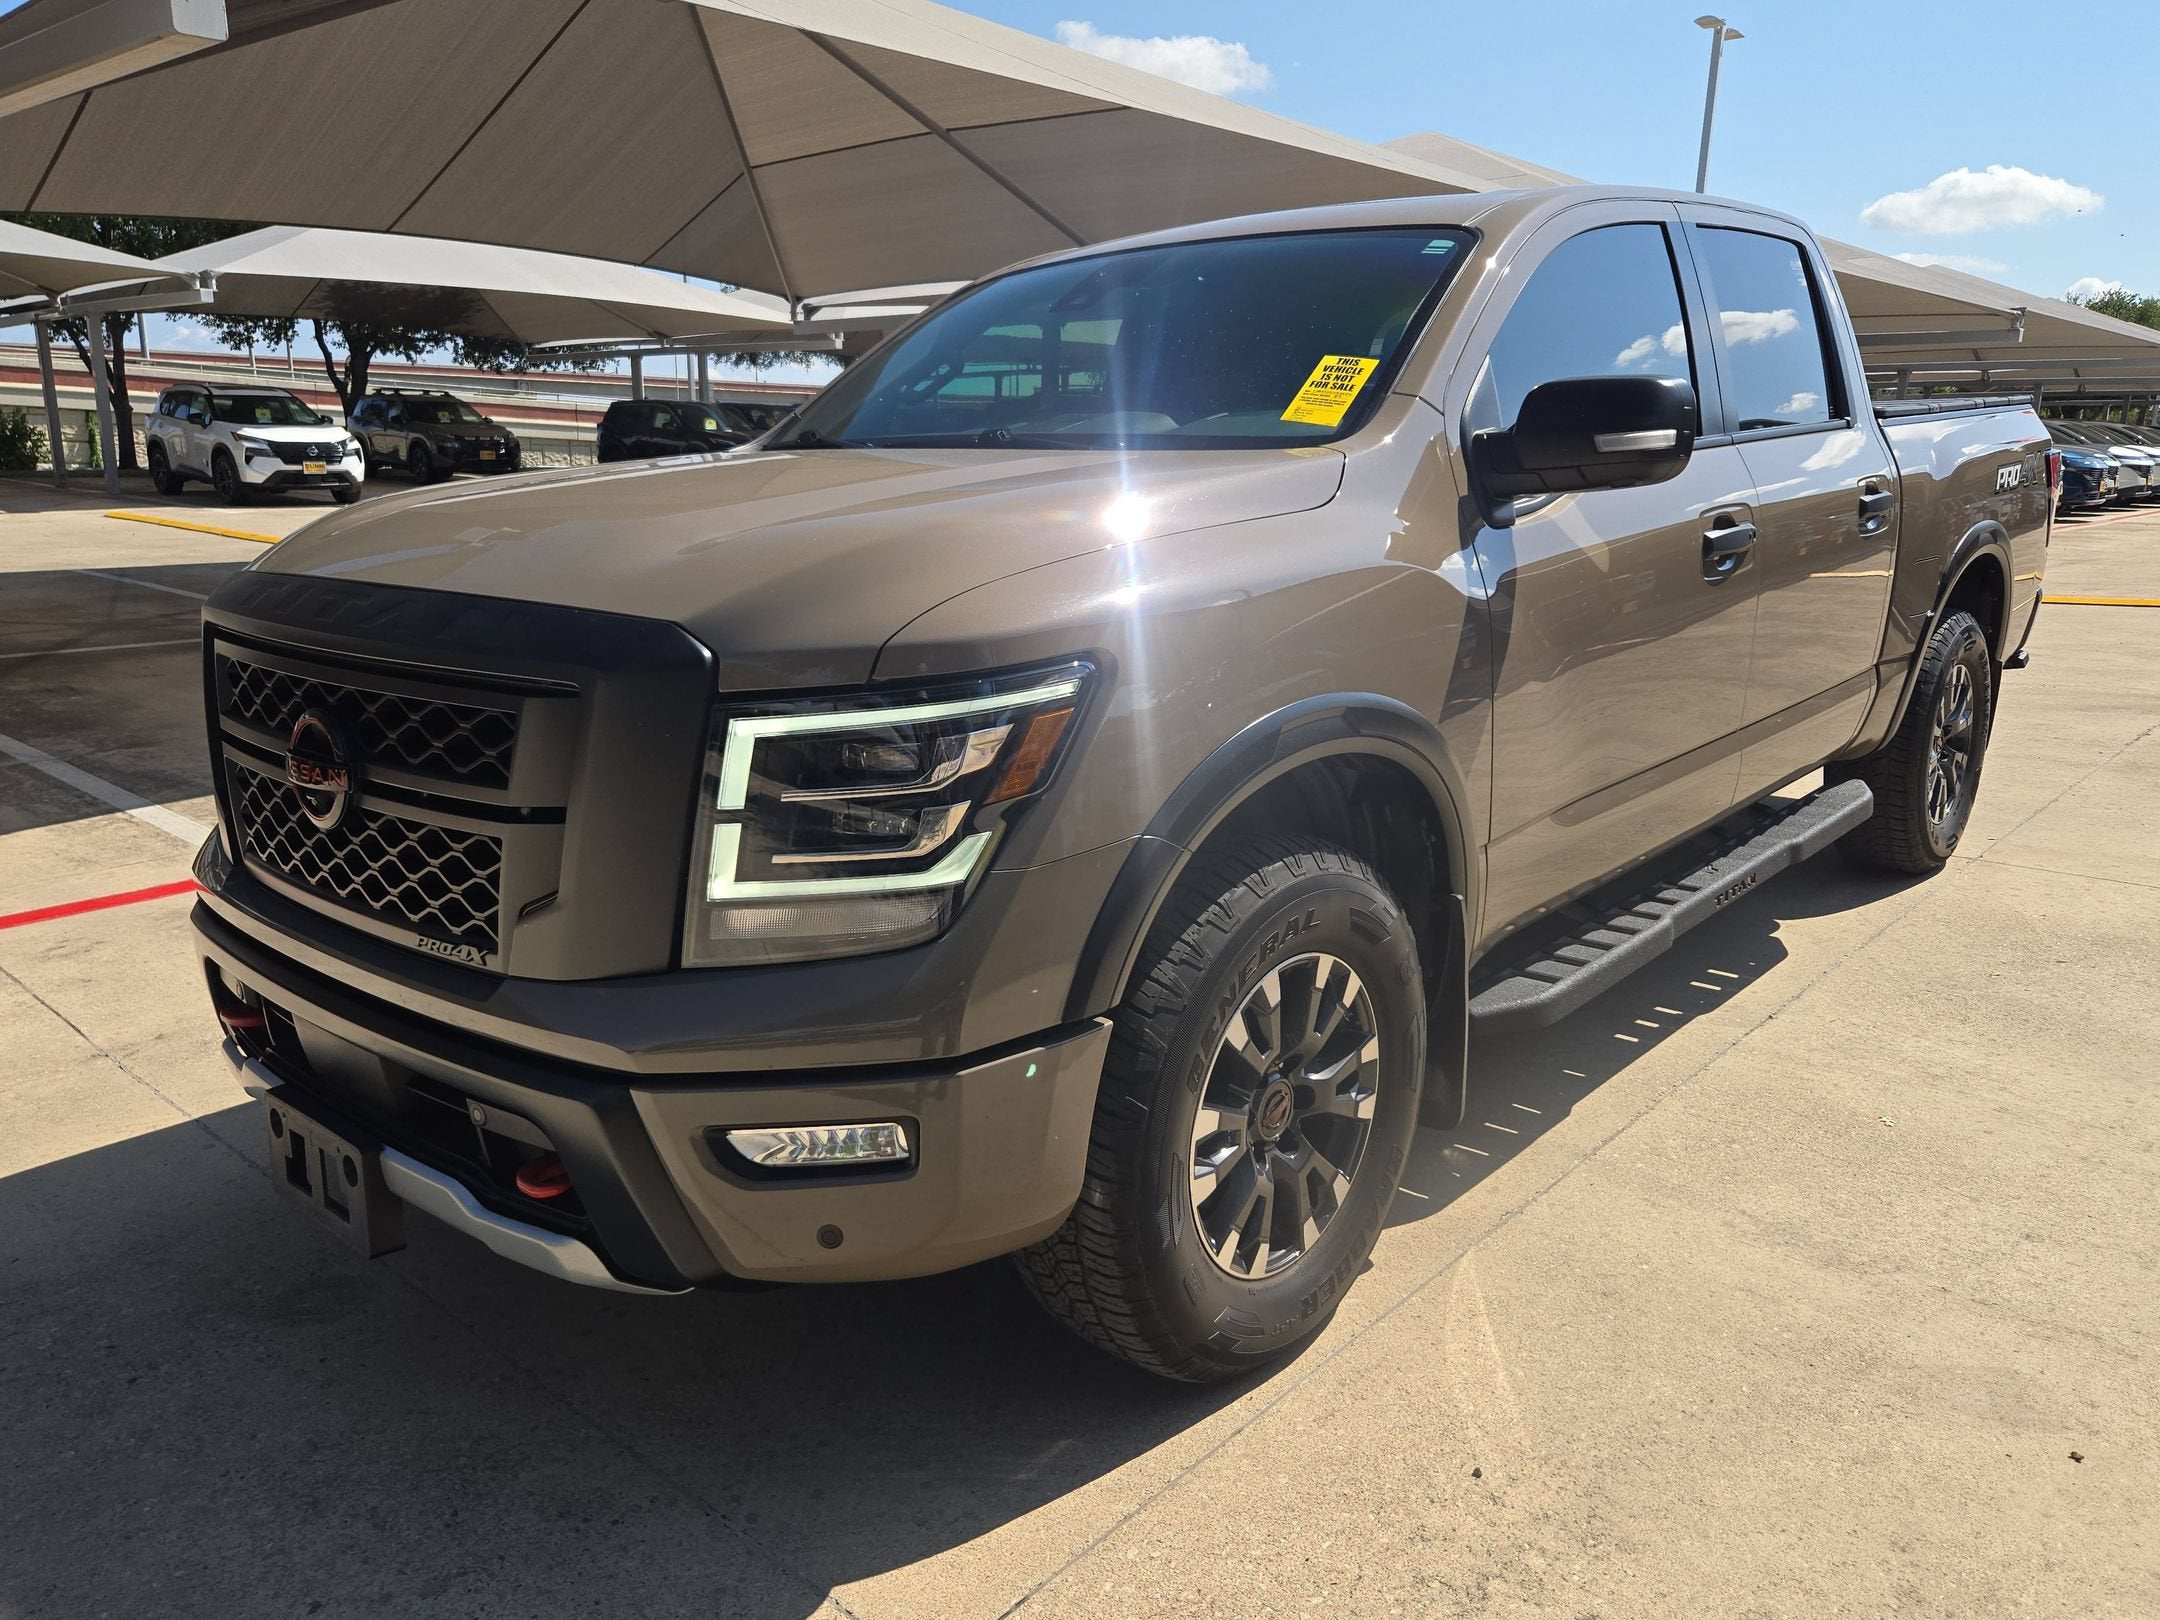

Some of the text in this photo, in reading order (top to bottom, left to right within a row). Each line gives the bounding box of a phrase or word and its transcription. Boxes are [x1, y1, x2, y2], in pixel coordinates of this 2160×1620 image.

[1336, 358, 1360, 366] THIS
[1322, 365, 1364, 375] VEHICLE
[1333, 374, 1355, 382] NOT
[1309, 381, 1356, 392] FOR SALE
[1714, 873, 1757, 908] TITAN
[416, 933, 490, 966] PRO4X
[1187, 907, 1321, 1094] GENERAL
